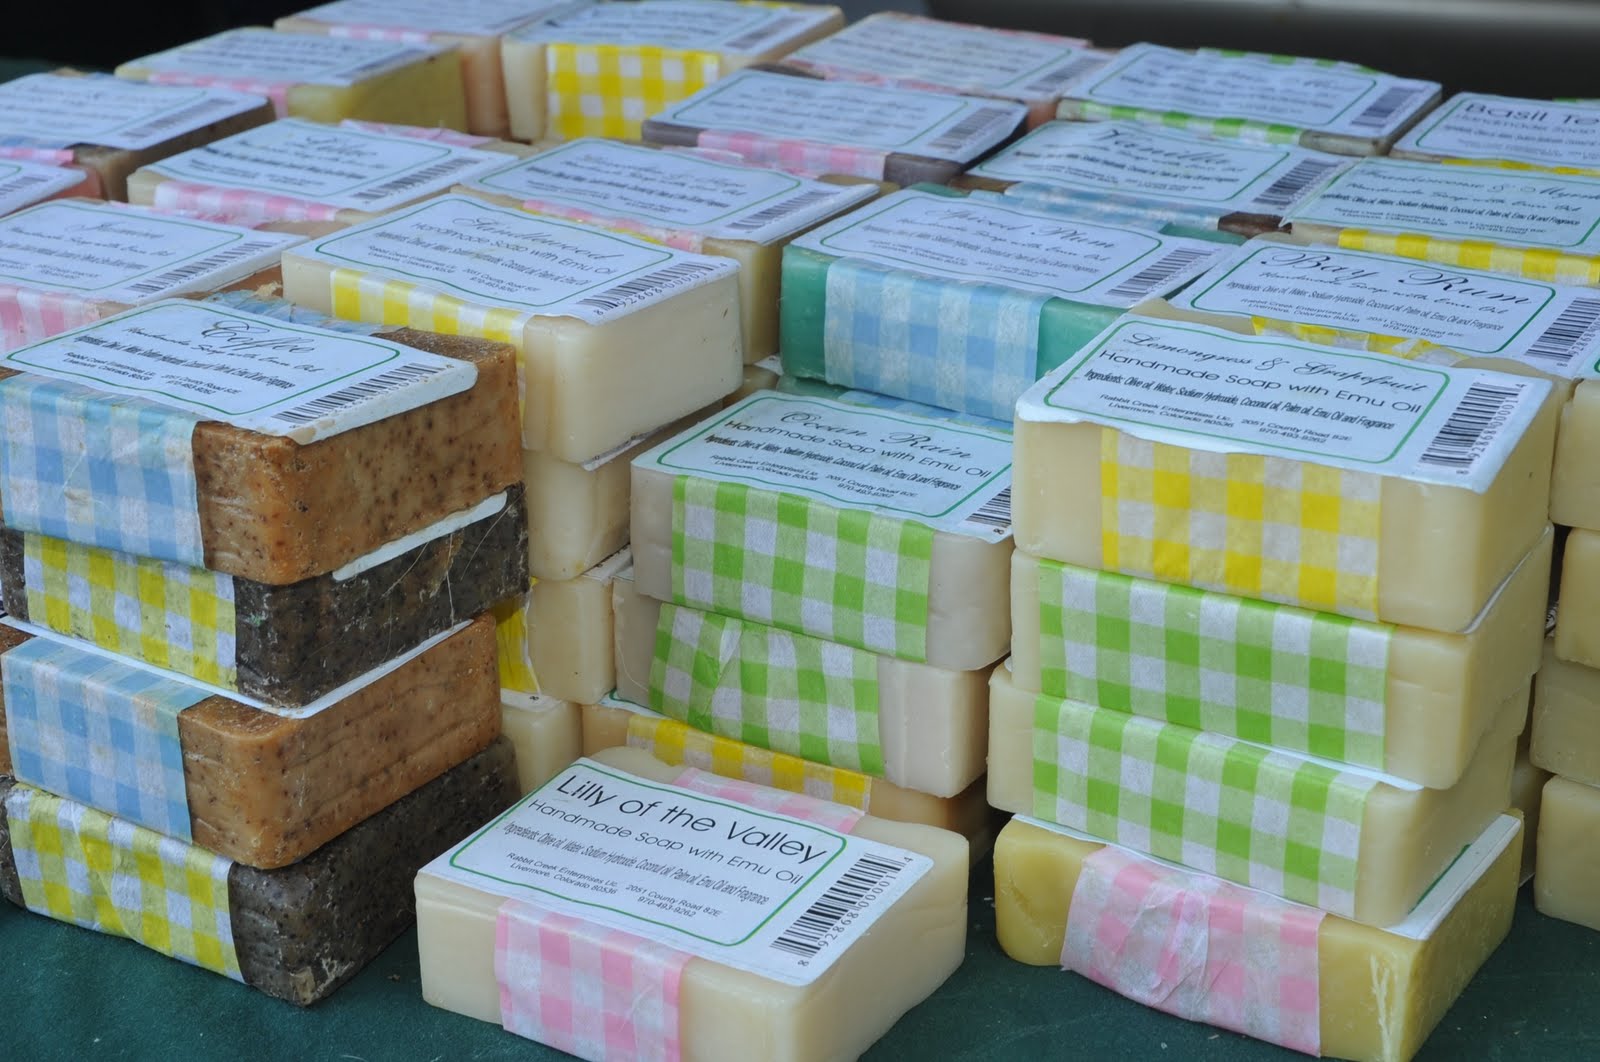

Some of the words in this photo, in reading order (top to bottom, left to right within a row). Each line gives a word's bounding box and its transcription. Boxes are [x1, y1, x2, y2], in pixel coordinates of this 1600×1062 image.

[1465, 103, 1549, 122] Basil
[530, 250, 559, 262] with
[558, 258, 594, 272] Emu
[1261, 253, 1380, 281] Bay
[1398, 268, 1532, 304] Rum
[1308, 290, 1334, 300] Sodium
[1366, 300, 1394, 310] Coconut
[1403, 306, 1421, 316] Palm
[1430, 312, 1448, 321] Emu
[1446, 314, 1458, 323] Oil
[1456, 316, 1472, 326] and
[1470, 318, 1504, 332] Fragrance
[201, 320, 316, 354] Coffee
[1099, 350, 1220, 381] Handmade
[1225, 375, 1282, 390] Soap
[1288, 380, 1330, 396] with
[1335, 390, 1386, 407] Emu
[1391, 401, 1422, 414] Oil
[1254, 357, 1290, 372] &
[1293, 361, 1428, 392] Grapefruit
[1084, 368, 1125, 384] Ingredients:
[1124, 376, 1144, 388] Olive
[1176, 386, 1205, 399] Sodium
[1240, 396, 1273, 410] Coconut
[1280, 402, 1301, 412] Palm
[1312, 407, 1332, 419] Emu
[1330, 410, 1346, 421] Oil
[1341, 414, 1359, 424] and
[1356, 416, 1396, 430] Fragrance
[1099, 394, 1130, 404] Rabbit
[1132, 400, 1159, 410] Creek
[1161, 406, 1214, 419] Enterprises
[1160, 411, 1202, 422] Colorado
[1241, 418, 1265, 426] 2051
[1267, 422, 1302, 433] County
[1304, 429, 1330, 438] Road
[724, 420, 826, 444] Handmade
[828, 438, 876, 454] Soap
[880, 450, 916, 462] with
[918, 457, 962, 472] Emu
[966, 467, 992, 478] Oil
[781, 411, 868, 437] Ocean
[880, 432, 972, 458] Rain
[1259, 428, 1327, 444] 970-493-9262
[892, 470, 909, 480] Emu
[928, 477, 962, 490] Fragrance
[556, 774, 618, 808] Lilly
[619, 799, 663, 817] of
[659, 806, 716, 832] the
[727, 821, 828, 864] Valley
[528, 799, 632, 838] Handmade
[635, 832, 684, 850] Soap
[688, 846, 724, 864] with
[727, 856, 772, 876] Emu
[776, 870, 804, 885] Oil
[506, 852, 534, 864] Rabbit
[534, 860, 558, 871] Creek
[558, 866, 603, 884] Enterprises
[537, 832, 557, 846] Olive
[581, 845, 608, 858] Sodium
[635, 858, 668, 874] Coconut
[670, 868, 690, 880] Palm
[696, 876, 715, 888] Emu
[712, 880, 729, 890] Oil
[721, 884, 740, 895] and
[734, 886, 770, 905] Fragrance
[553, 874, 590, 890] Colorado
[590, 886, 618, 895] 80536
[626, 884, 648, 894] 2051
[648, 890, 678, 904] County
[679, 899, 704, 911] Road
[702, 906, 723, 918] 82E
[637, 896, 696, 918] 970-493-9262
[797, 959, 810, 967] 8
[818, 912, 860, 948] 92868
